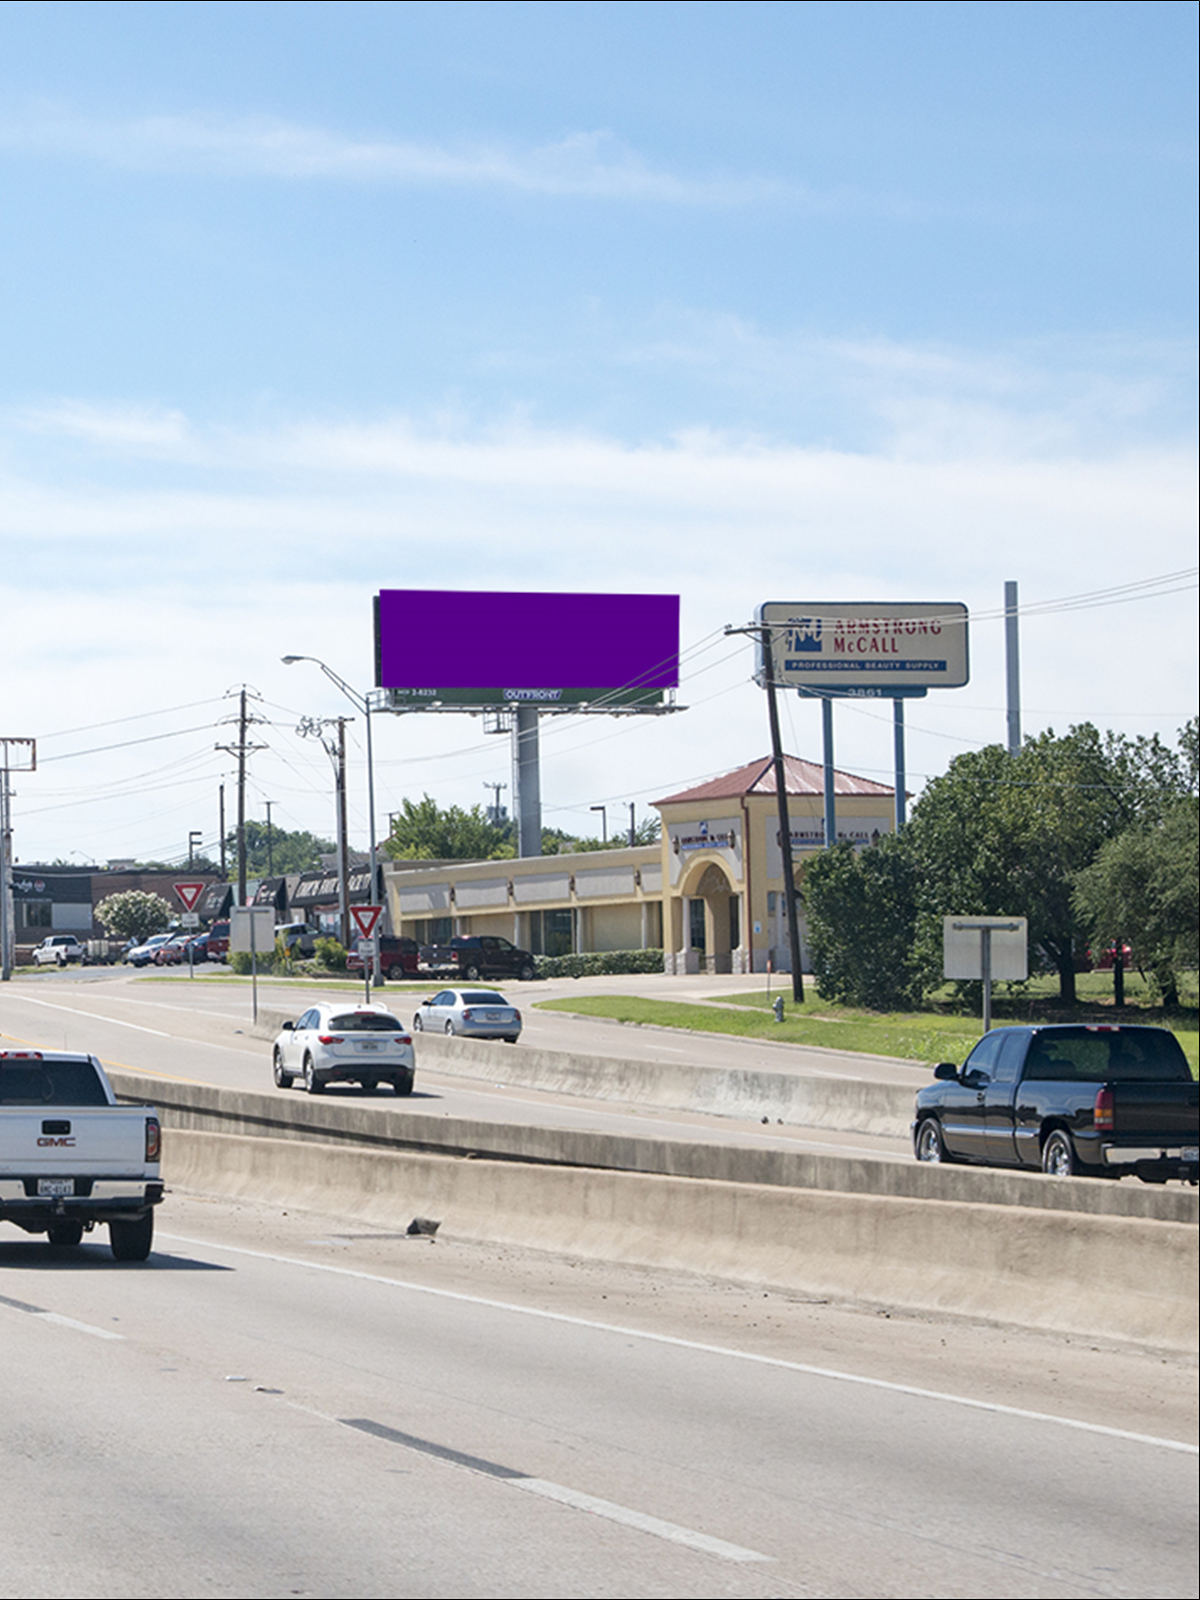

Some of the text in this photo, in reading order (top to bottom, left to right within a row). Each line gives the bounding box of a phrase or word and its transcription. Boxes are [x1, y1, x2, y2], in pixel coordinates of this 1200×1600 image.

[834, 618, 942, 635] ARMSTRONG
[834, 637, 900, 653] McCALL
[503, 689, 563, 700] OUTFRONT
[848, 688, 882, 697] 3861
[36, 1137, 76, 1147] GMC
